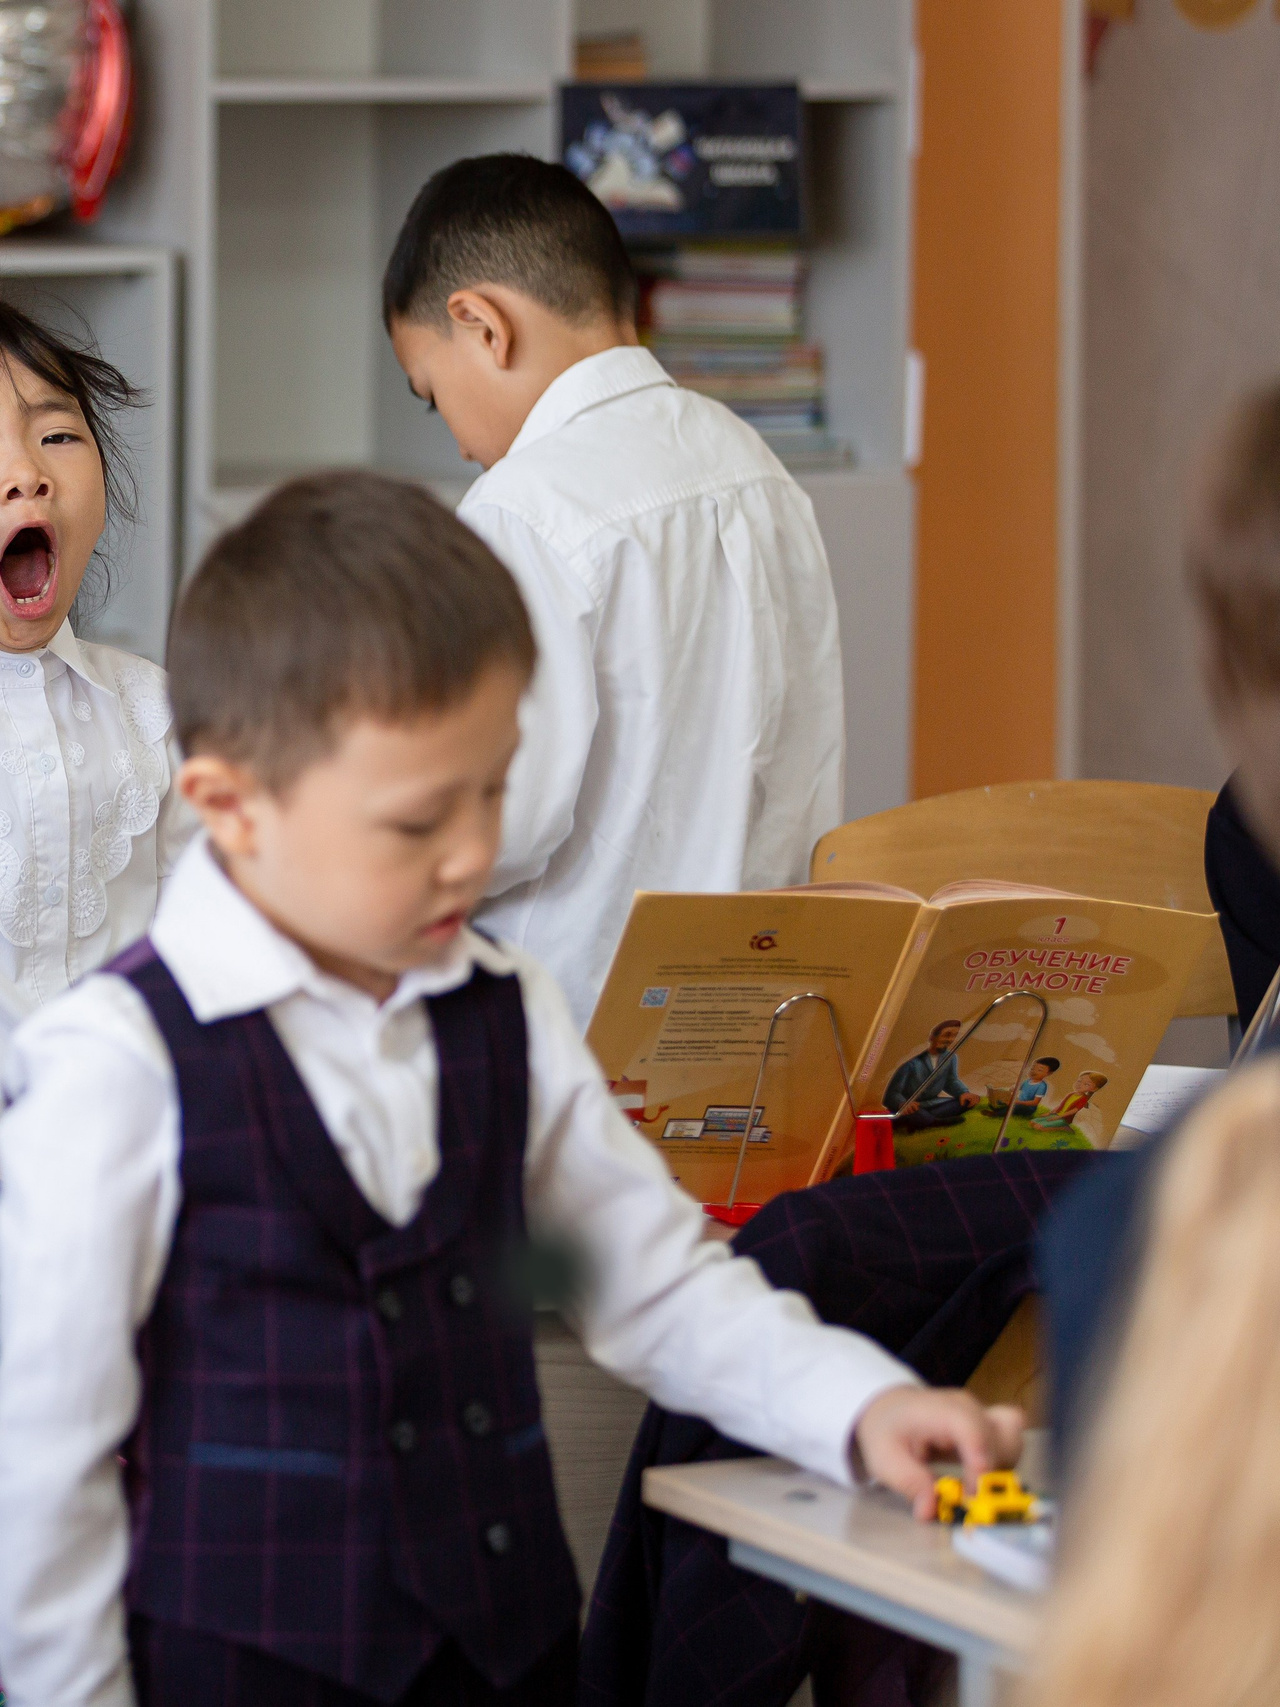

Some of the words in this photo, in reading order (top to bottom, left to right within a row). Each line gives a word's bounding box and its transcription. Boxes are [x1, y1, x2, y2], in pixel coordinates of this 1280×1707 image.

[1054, 917, 1067, 934] 1
[964, 949, 1131, 975] ОБУЧЕНИЕ
[966, 971, 1107, 994] ГРАМОТЕ
